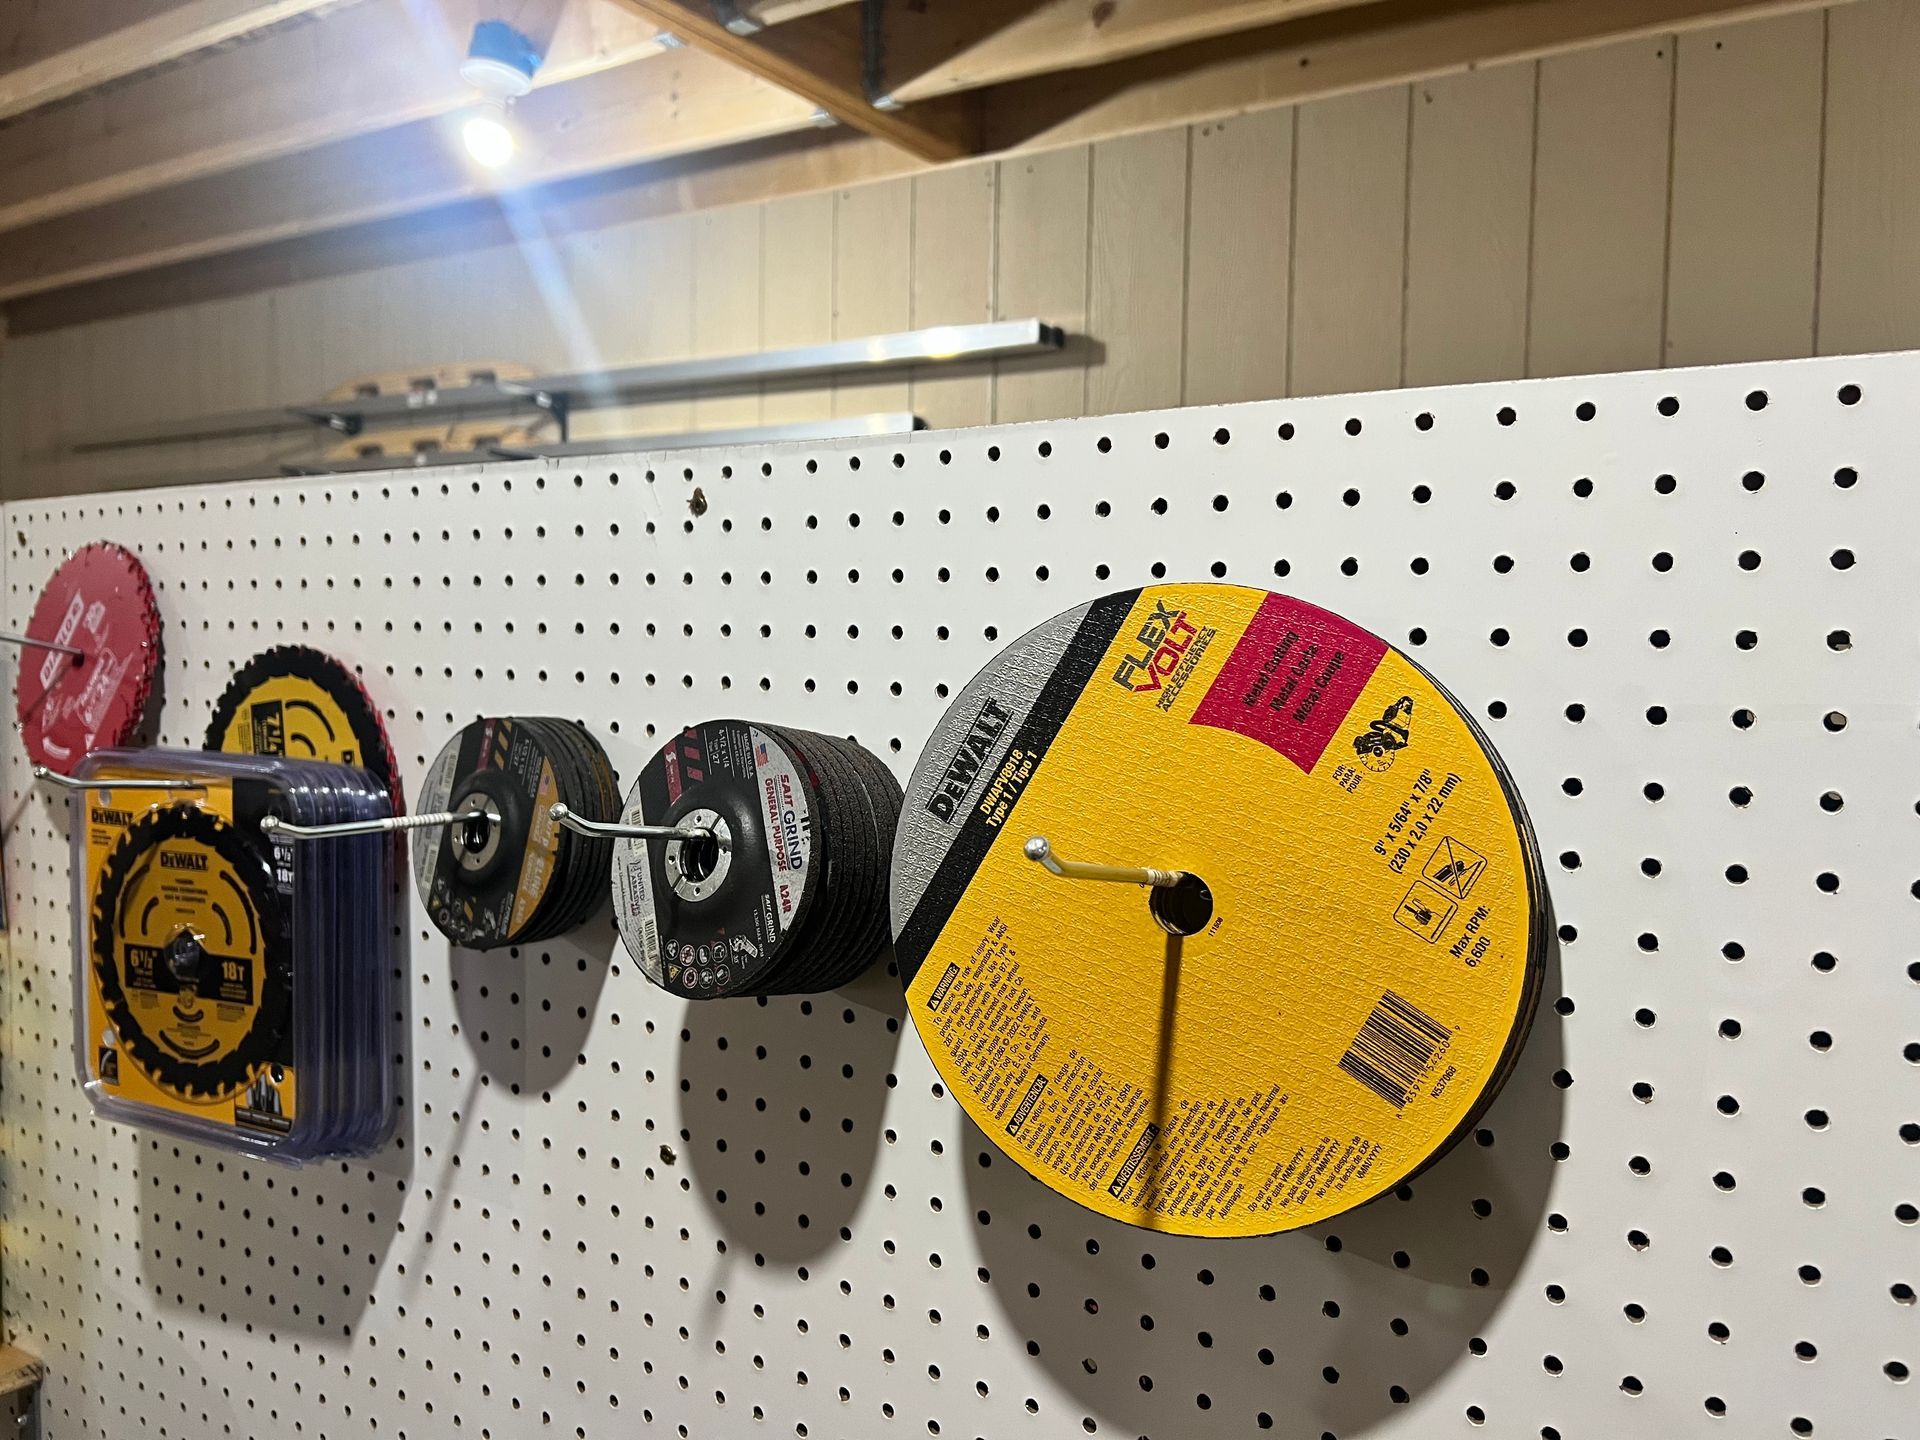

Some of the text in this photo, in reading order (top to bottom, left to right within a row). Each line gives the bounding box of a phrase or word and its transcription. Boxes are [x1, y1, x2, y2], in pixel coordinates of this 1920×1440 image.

[1113, 602, 1177, 688] FLEX
[1135, 612, 1195, 692] VOLT
[1155, 626, 1209, 708] HIGH EFFICIENCY
[1163, 629, 1215, 711] ACCESSORIES
[1243, 630, 1295, 707] Metal Cutting
[1271, 678, 1296, 709] Metal
[1295, 690, 1319, 721] Metal
[712, 753, 719, 763] 27
[980, 750, 1022, 813] DWAFV8918
[985, 801, 1007, 826] Type
[1011, 760, 1031, 783] Tipo
[1331, 764, 1346, 780] FOR:
[1338, 766, 1356, 787] PARA:
[764, 777, 786, 871] GENERAL PURPOSE
[780, 774, 802, 869] SAIT GRIND
[1388, 800, 1411, 832] 5/64"
[1412, 768, 1432, 793] 7/8"
[1388, 847, 1410, 873] (230
[1409, 820, 1427, 840] 2,0
[1426, 796, 1443, 812] 22
[1438, 772, 1461, 798] mm)
[636, 871, 645, 900] UNITED
[779, 884, 791, 913] A24R
[764, 912, 775, 942] GRIND
[1449, 905, 1490, 958] Max RPM:
[1465, 936, 1490, 967] 6,600
[932, 1016, 942, 1025] To
[940, 992, 955, 1015] reduce
[953, 980, 963, 991] the
[961, 965, 971, 979] risk
[969, 955, 977, 964] of
[986, 915, 1000, 933] Wear
[934, 966, 957, 999] WARNING:
[939, 1016, 953, 1037] proper
[950, 1000, 964, 1015] face,
[960, 982, 975, 998] body,
[972, 947, 994, 980] respiratory
[995, 922, 1008, 939] ANSI
[955, 1014, 965, 1027] eye
[963, 982, 985, 1014] protection
[986, 960, 998, 973] Use
[994, 942, 1008, 958] Type
[949, 1037, 963, 1057] guard
[964, 1006, 982, 1030] Comply
[980, 990, 991, 1005] with
[989, 972, 1001, 990] ANSI
[954, 1048, 969, 1066] OSHA
[969, 1032, 978, 1042] Do
[976, 1020, 985, 1032] not
[983, 996, 999, 1020] exceed
[996, 982, 1008, 997] max
[1005, 961, 1020, 982] wheel
[960, 1060, 974, 1076] RPM.
[987, 1001, 1007, 1031] Industrial
[1004, 986, 1017, 1001] Tool
[1014, 974, 1024, 985] Co.
[967, 987, 1030, 1085] 701 East Joppa Road, Towson,
[973, 1065, 993, 1094] Maryland
[1005, 1022, 1019, 1039] 2022
[979, 1073, 1000, 1103] Industrial
[998, 1055, 1011, 1070] Tool
[1009, 1041, 1022, 1053] Co.,
[1030, 1005, 1041, 1020] and
[986, 1087, 1004, 1111] Canada
[1024, 1041, 1032, 1050] et
[1029, 1016, 1047, 1041] Canada
[994, 1033, 1050, 1120] seulement. Made in Germany.
[1405, 1073, 1428, 1103] 85911
[1425, 1040, 1450, 1071] 54260
[1014, 1078, 1045, 1124] ADVERTENCIA:
[1247, 1162, 1283, 1212] Do not use past
[1261, 1196, 1273, 1211] EXP
[1271, 1182, 1284, 1197] date
